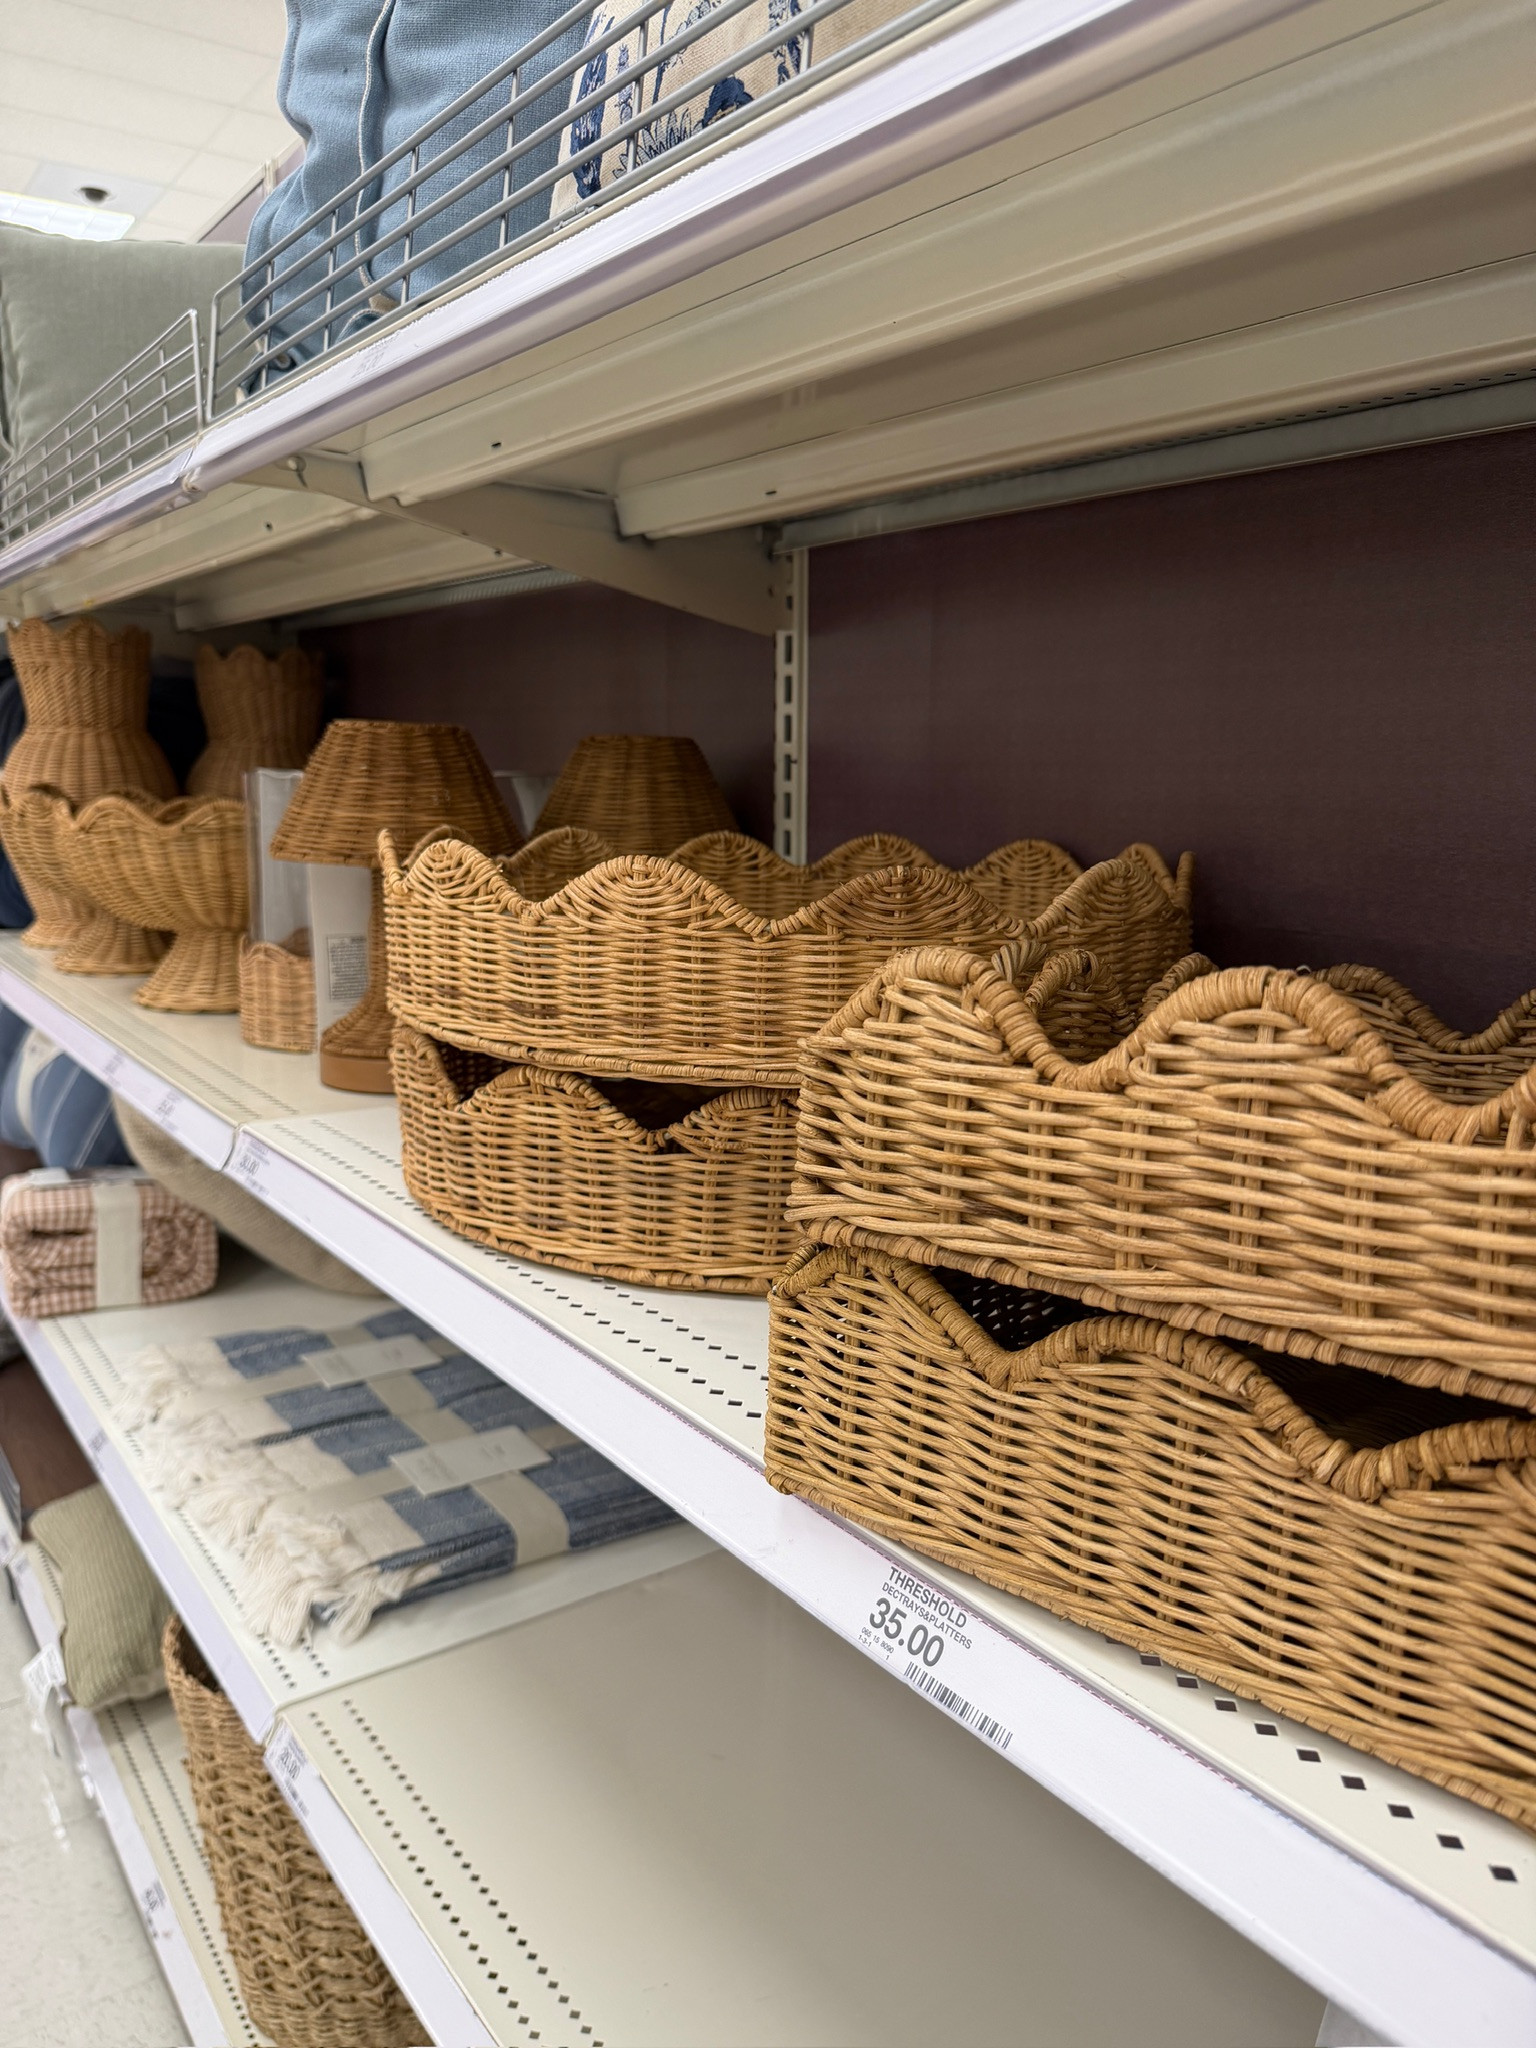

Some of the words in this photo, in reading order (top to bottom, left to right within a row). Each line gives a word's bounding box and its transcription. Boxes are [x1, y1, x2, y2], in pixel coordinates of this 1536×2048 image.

[882, 1582, 973, 1650] DECTRAYS&PLATTERS
[889, 1566, 967, 1628] THRESHOLD
[869, 1597, 945, 1667] 35.00
